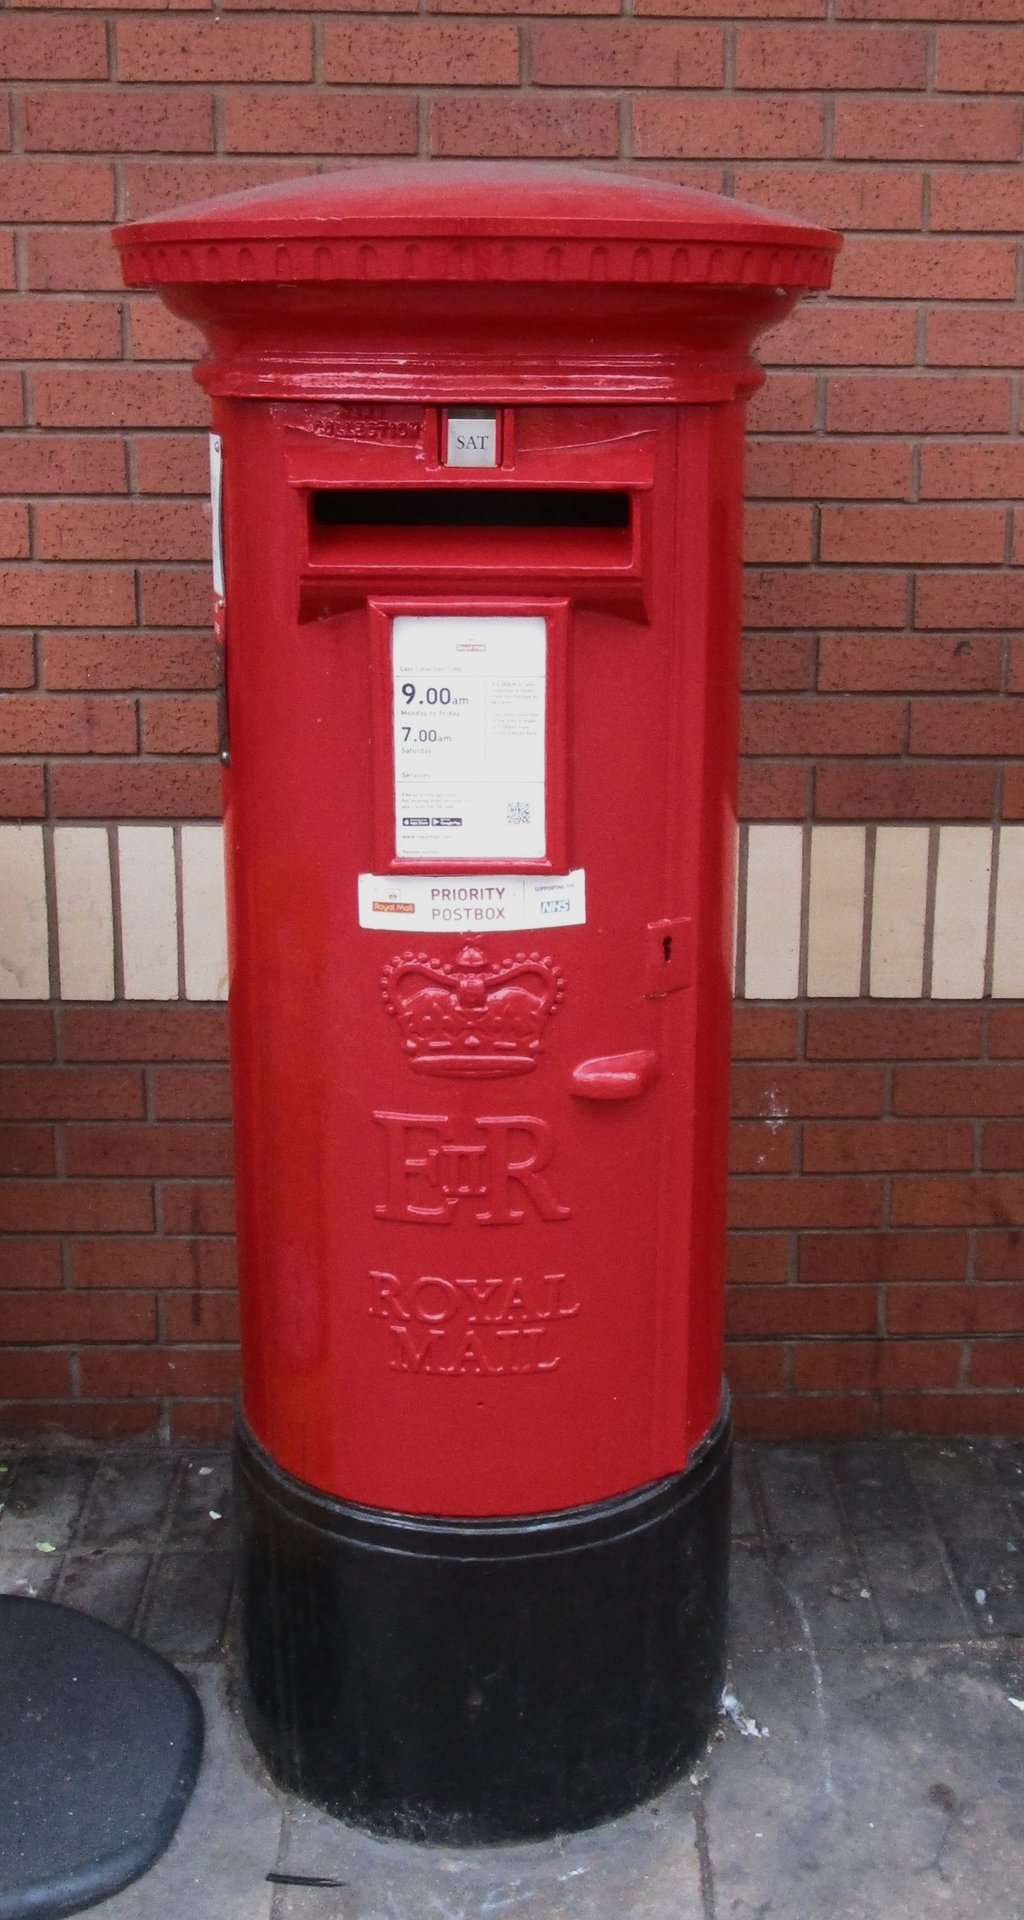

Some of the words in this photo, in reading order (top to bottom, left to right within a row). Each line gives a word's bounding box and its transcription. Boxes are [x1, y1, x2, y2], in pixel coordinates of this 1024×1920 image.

[456, 435, 489, 450] SAT
[401, 683, 469, 705] 9.00am
[438, 710, 460, 718] Friday
[401, 726, 452, 743] 7.00am
[401, 747, 431, 755] Saturday
[431, 887, 506, 901] PRIORITY
[374, 902, 395, 912] Royal
[396, 904, 413, 912] Mail
[541, 899, 569, 913] NHS
[431, 907, 505, 921] POSTBOX
[368, 1270, 580, 1325] ROYAL
[389, 1325, 560, 1376] MAIL
